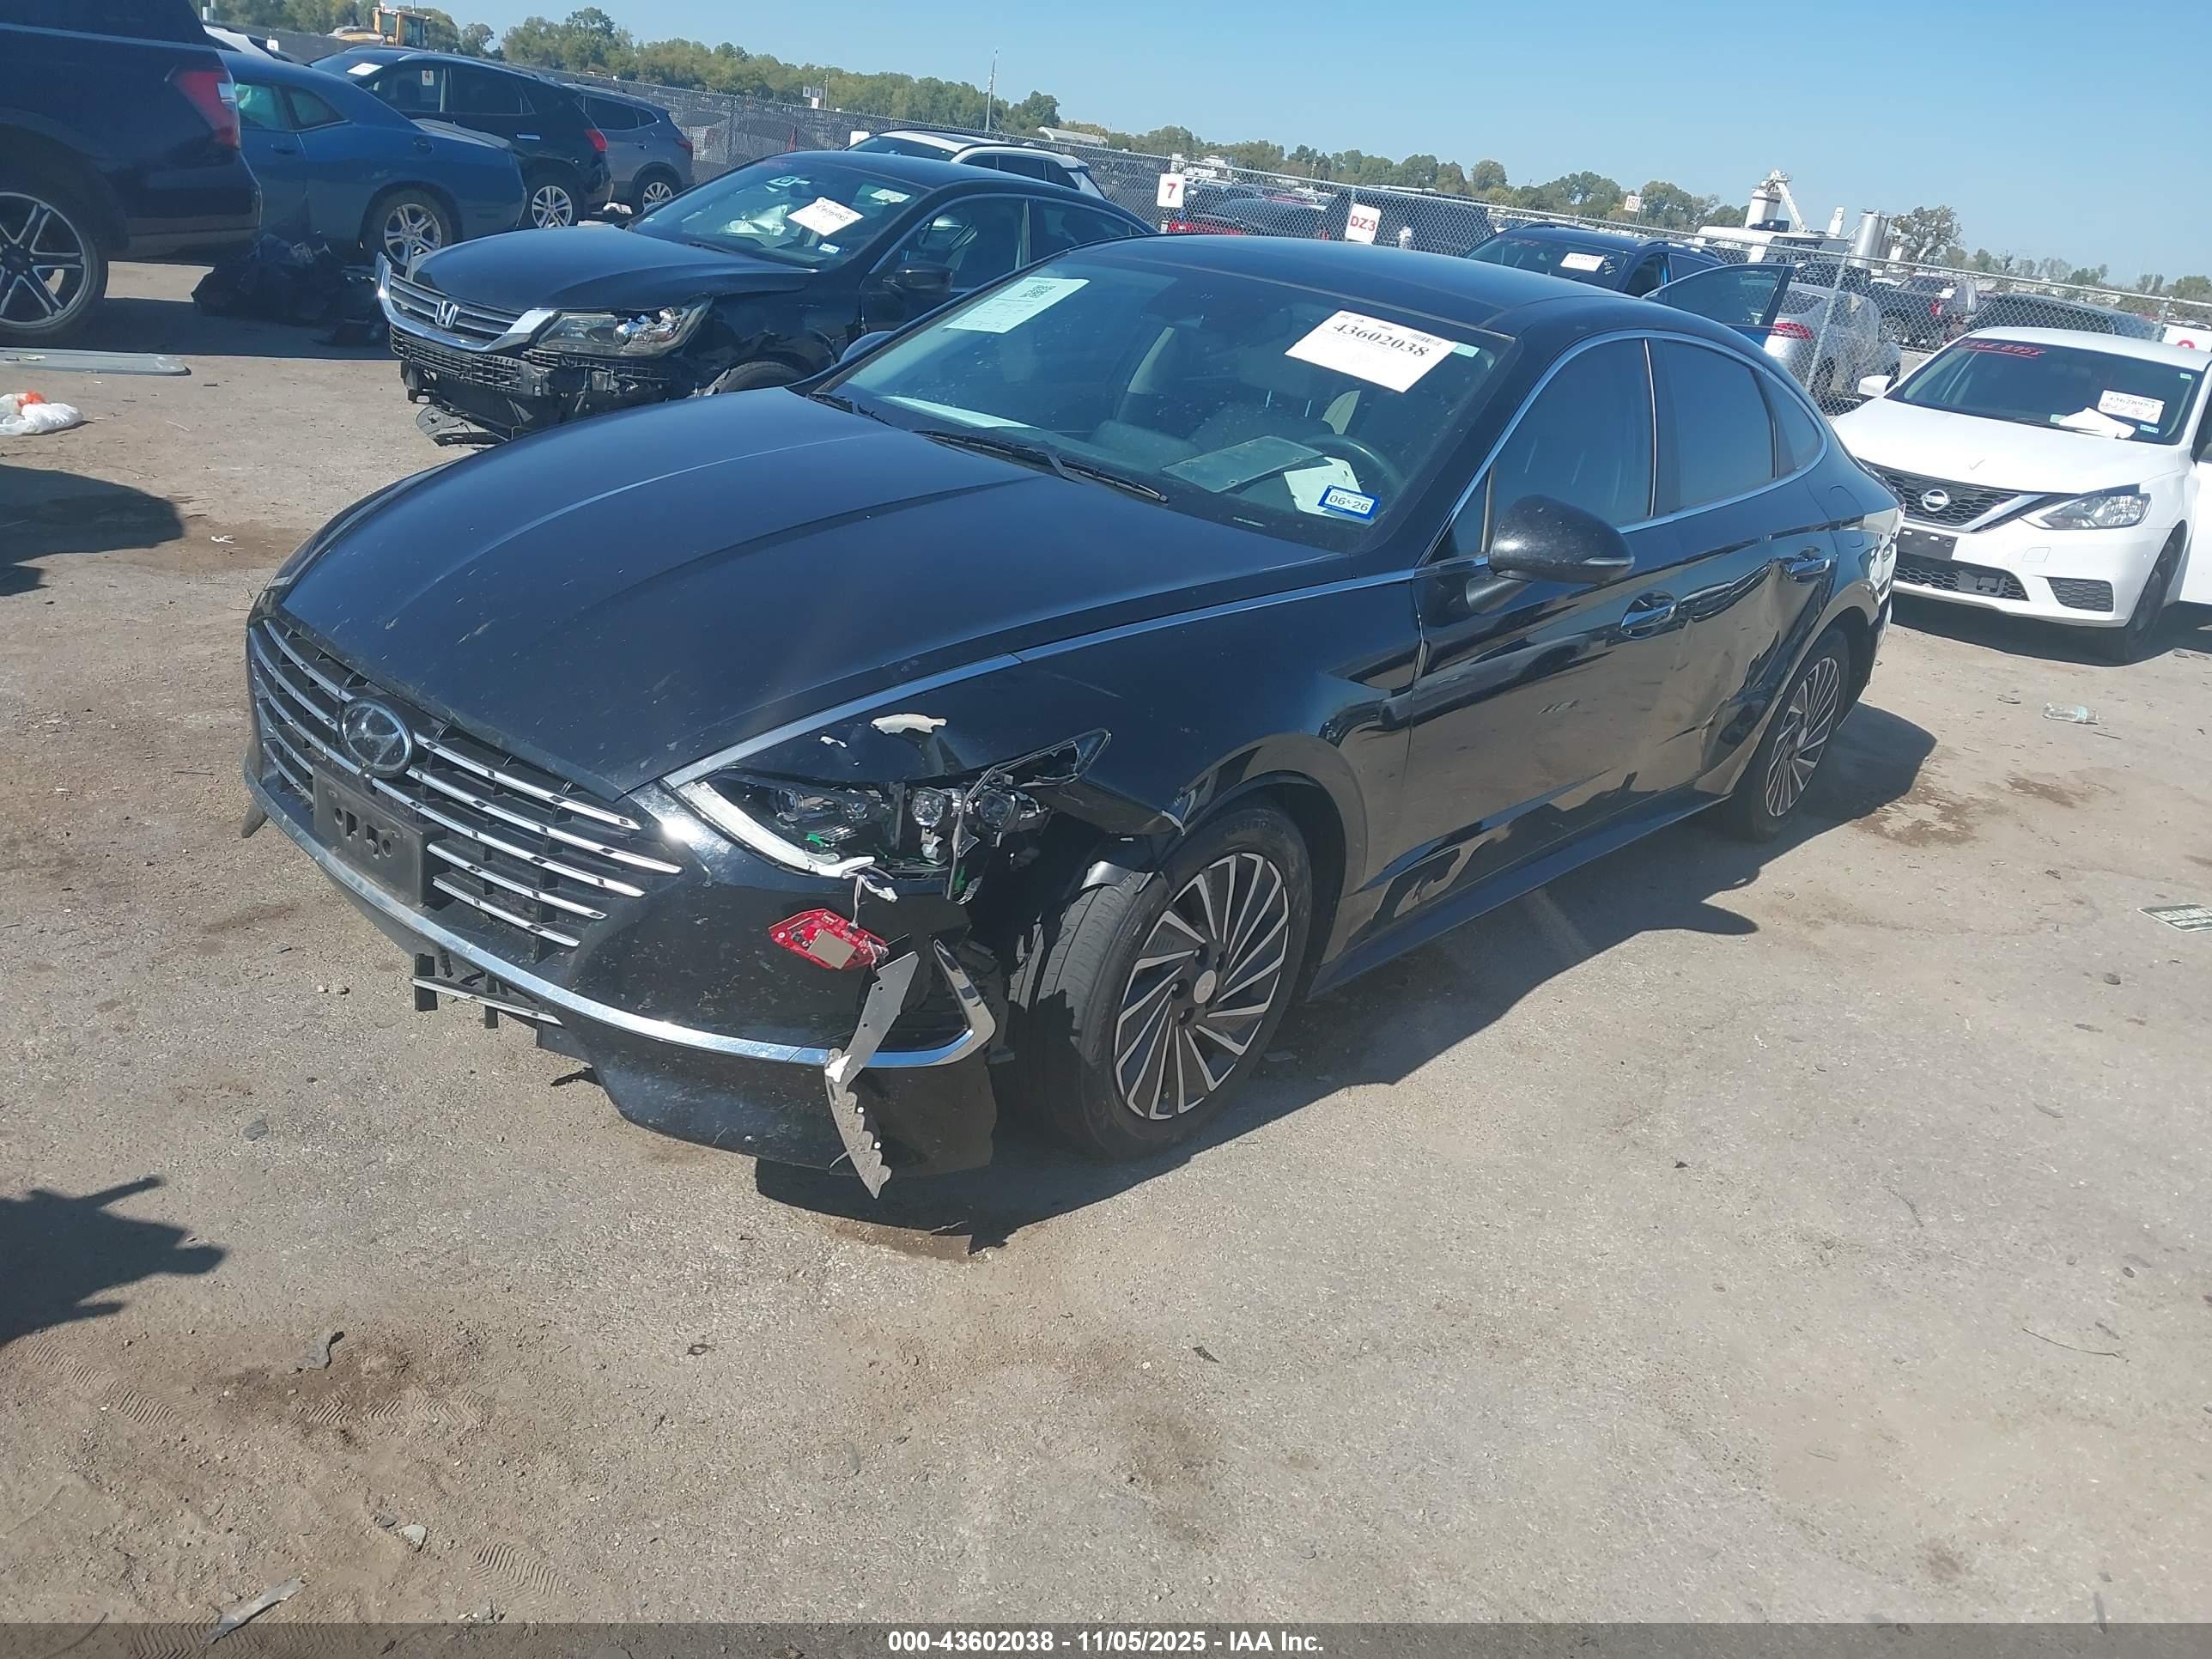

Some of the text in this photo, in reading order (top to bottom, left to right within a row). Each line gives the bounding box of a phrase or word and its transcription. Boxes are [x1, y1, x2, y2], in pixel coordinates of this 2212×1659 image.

[1167, 183, 1177, 199] 7
[1350, 216, 1376, 232] DZ3
[1333, 324, 1430, 357] 43602038
[1329, 495, 1370, 511] 06 26
